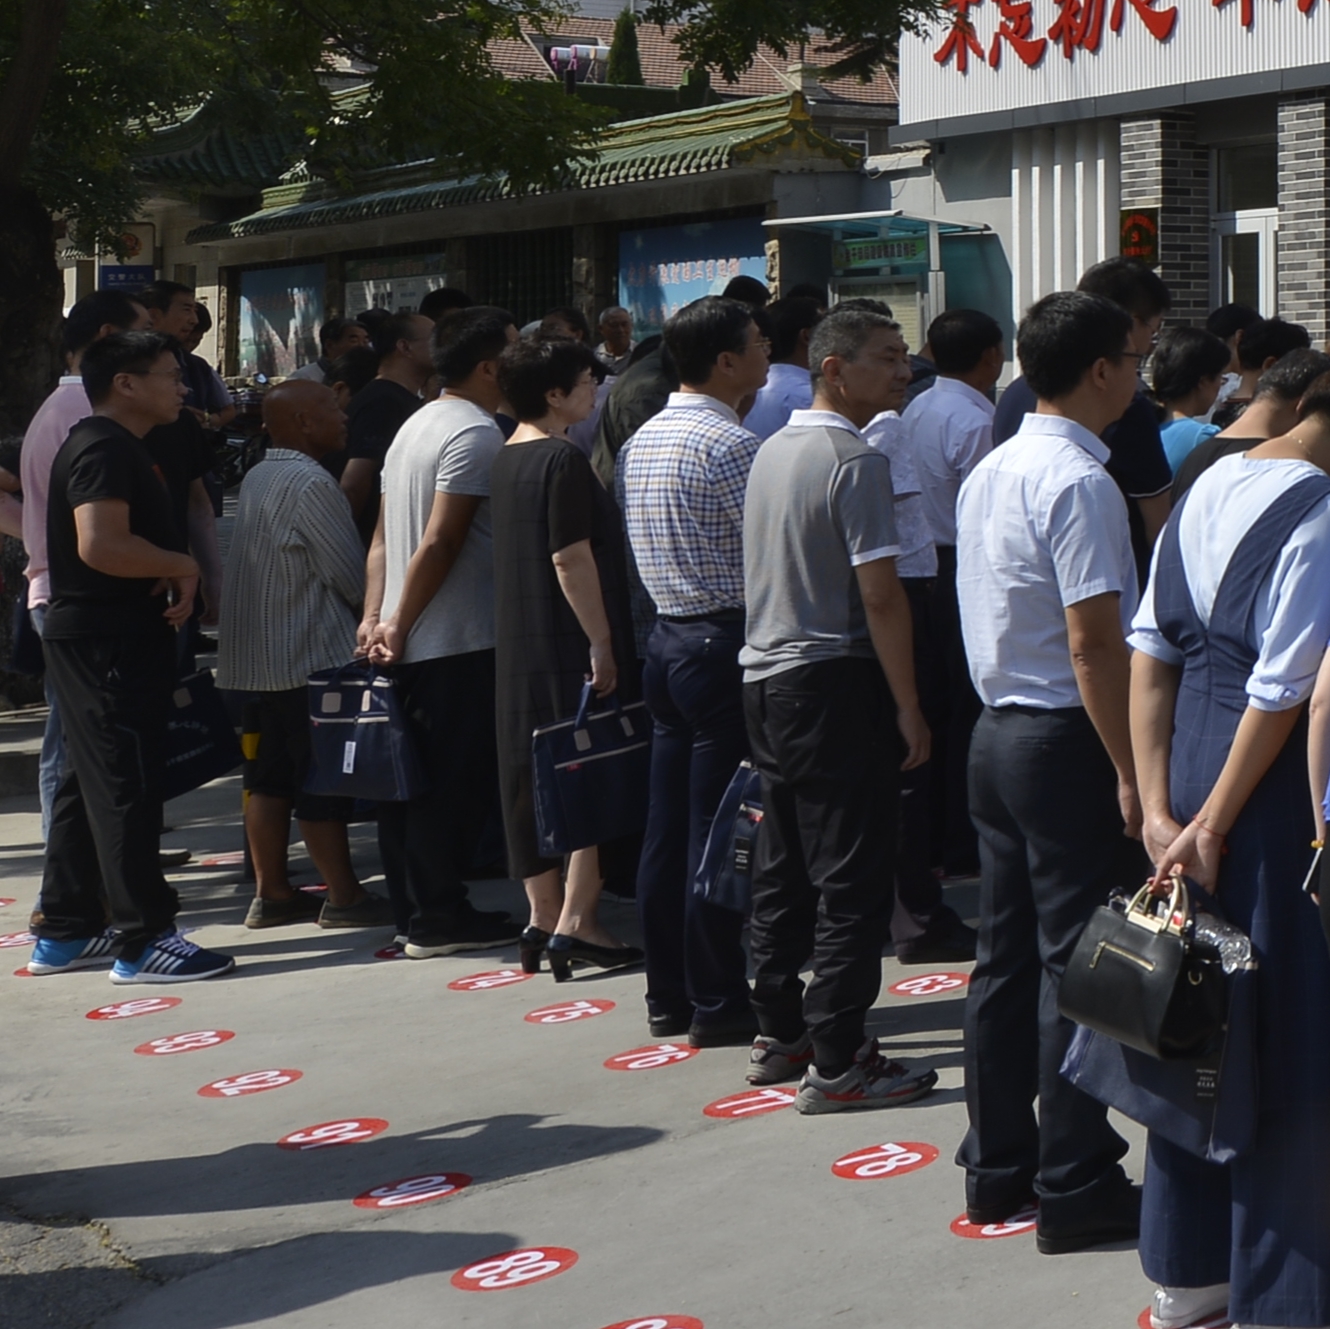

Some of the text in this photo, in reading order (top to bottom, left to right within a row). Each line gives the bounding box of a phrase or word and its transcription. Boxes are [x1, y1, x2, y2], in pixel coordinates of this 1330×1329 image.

[458, 971, 525, 990] 74
[895, 974, 963, 995] 63
[99, 998, 170, 1019] 94
[531, 1001, 603, 1023] 75
[150, 1031, 220, 1055] 93
[614, 1045, 690, 1069] 76
[212, 1070, 291, 1097] 92
[717, 1088, 796, 1114] 77
[287, 1122, 372, 1150] 91
[835, 1142, 922, 1176] 78
[370, 1176, 455, 1207] 90
[463, 1251, 561, 1288] 89
